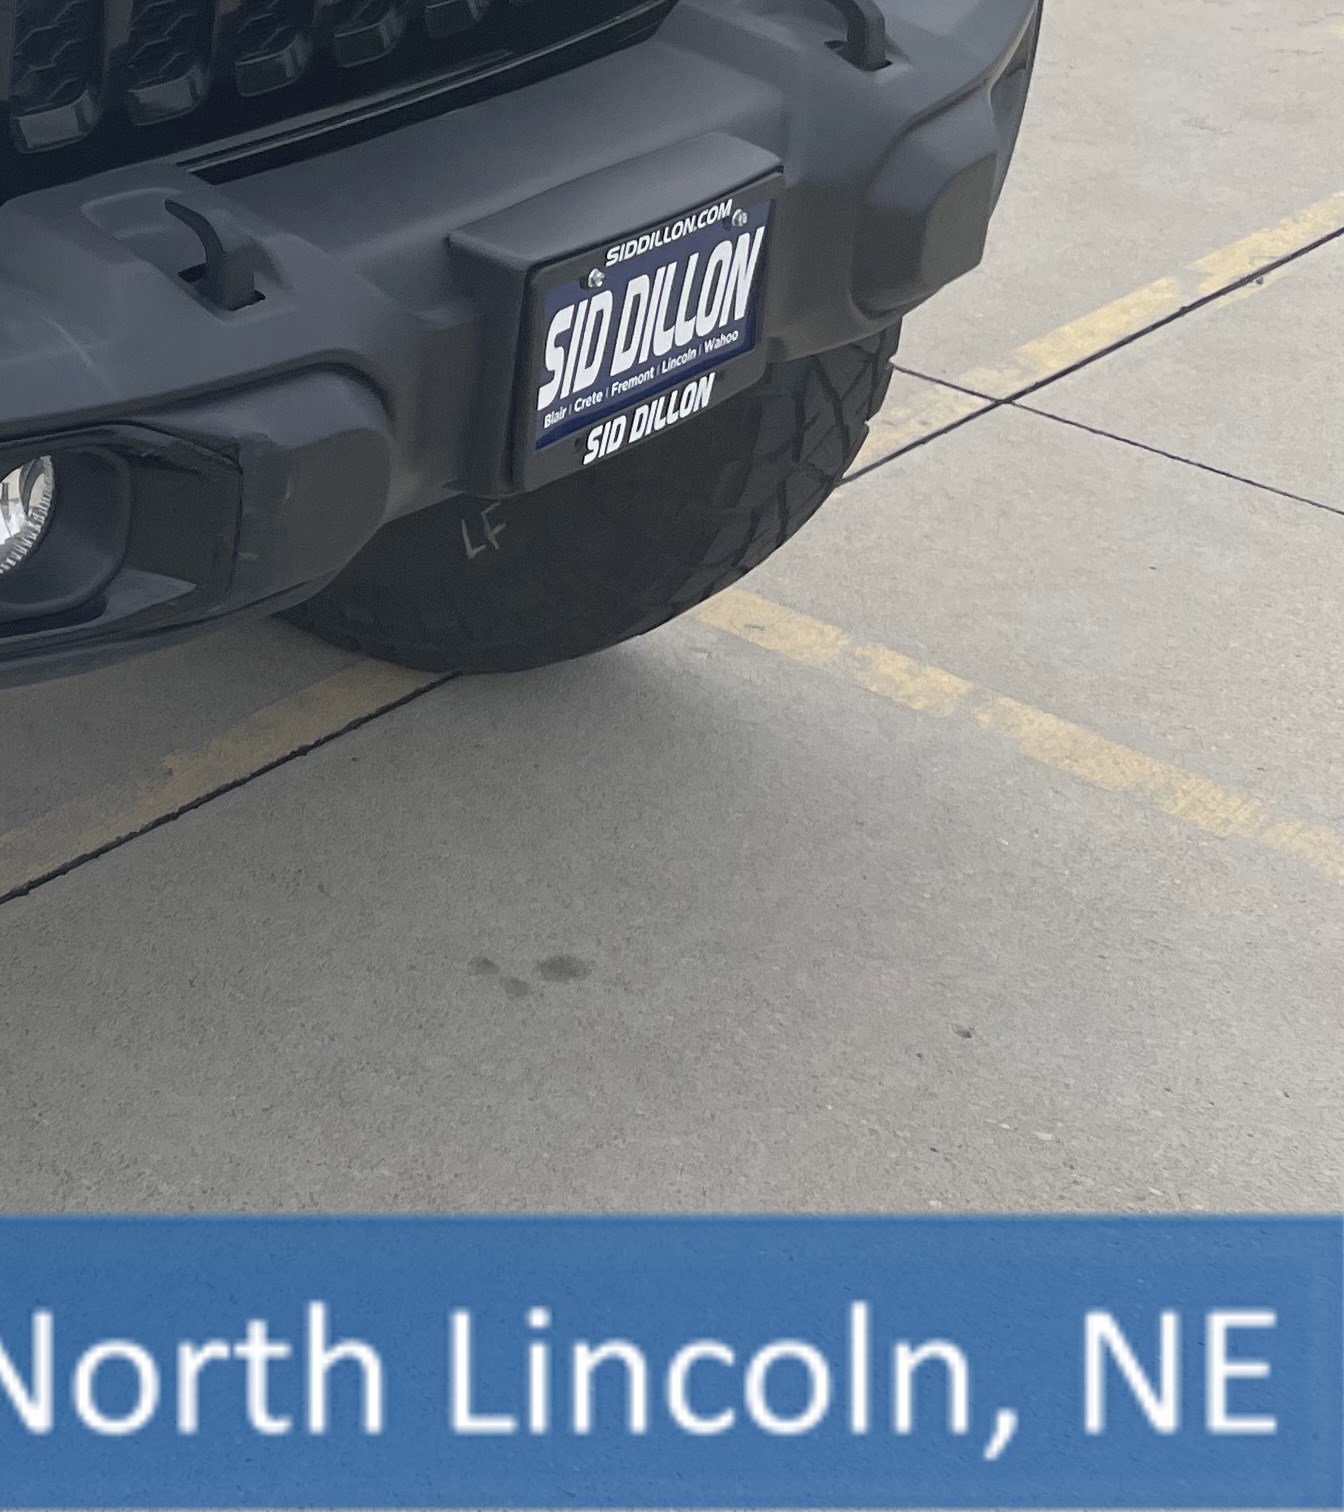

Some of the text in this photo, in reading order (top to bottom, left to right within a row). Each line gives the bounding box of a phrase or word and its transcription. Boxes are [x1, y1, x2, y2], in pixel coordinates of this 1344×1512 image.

[604, 198, 733, 267] SIDDILLON.COM
[537, 226, 765, 411] SID DILLON
[543, 329, 739, 429] Blair Crete Fremont Lincoln Wahoo
[583, 372, 717, 465] SID DILLON
